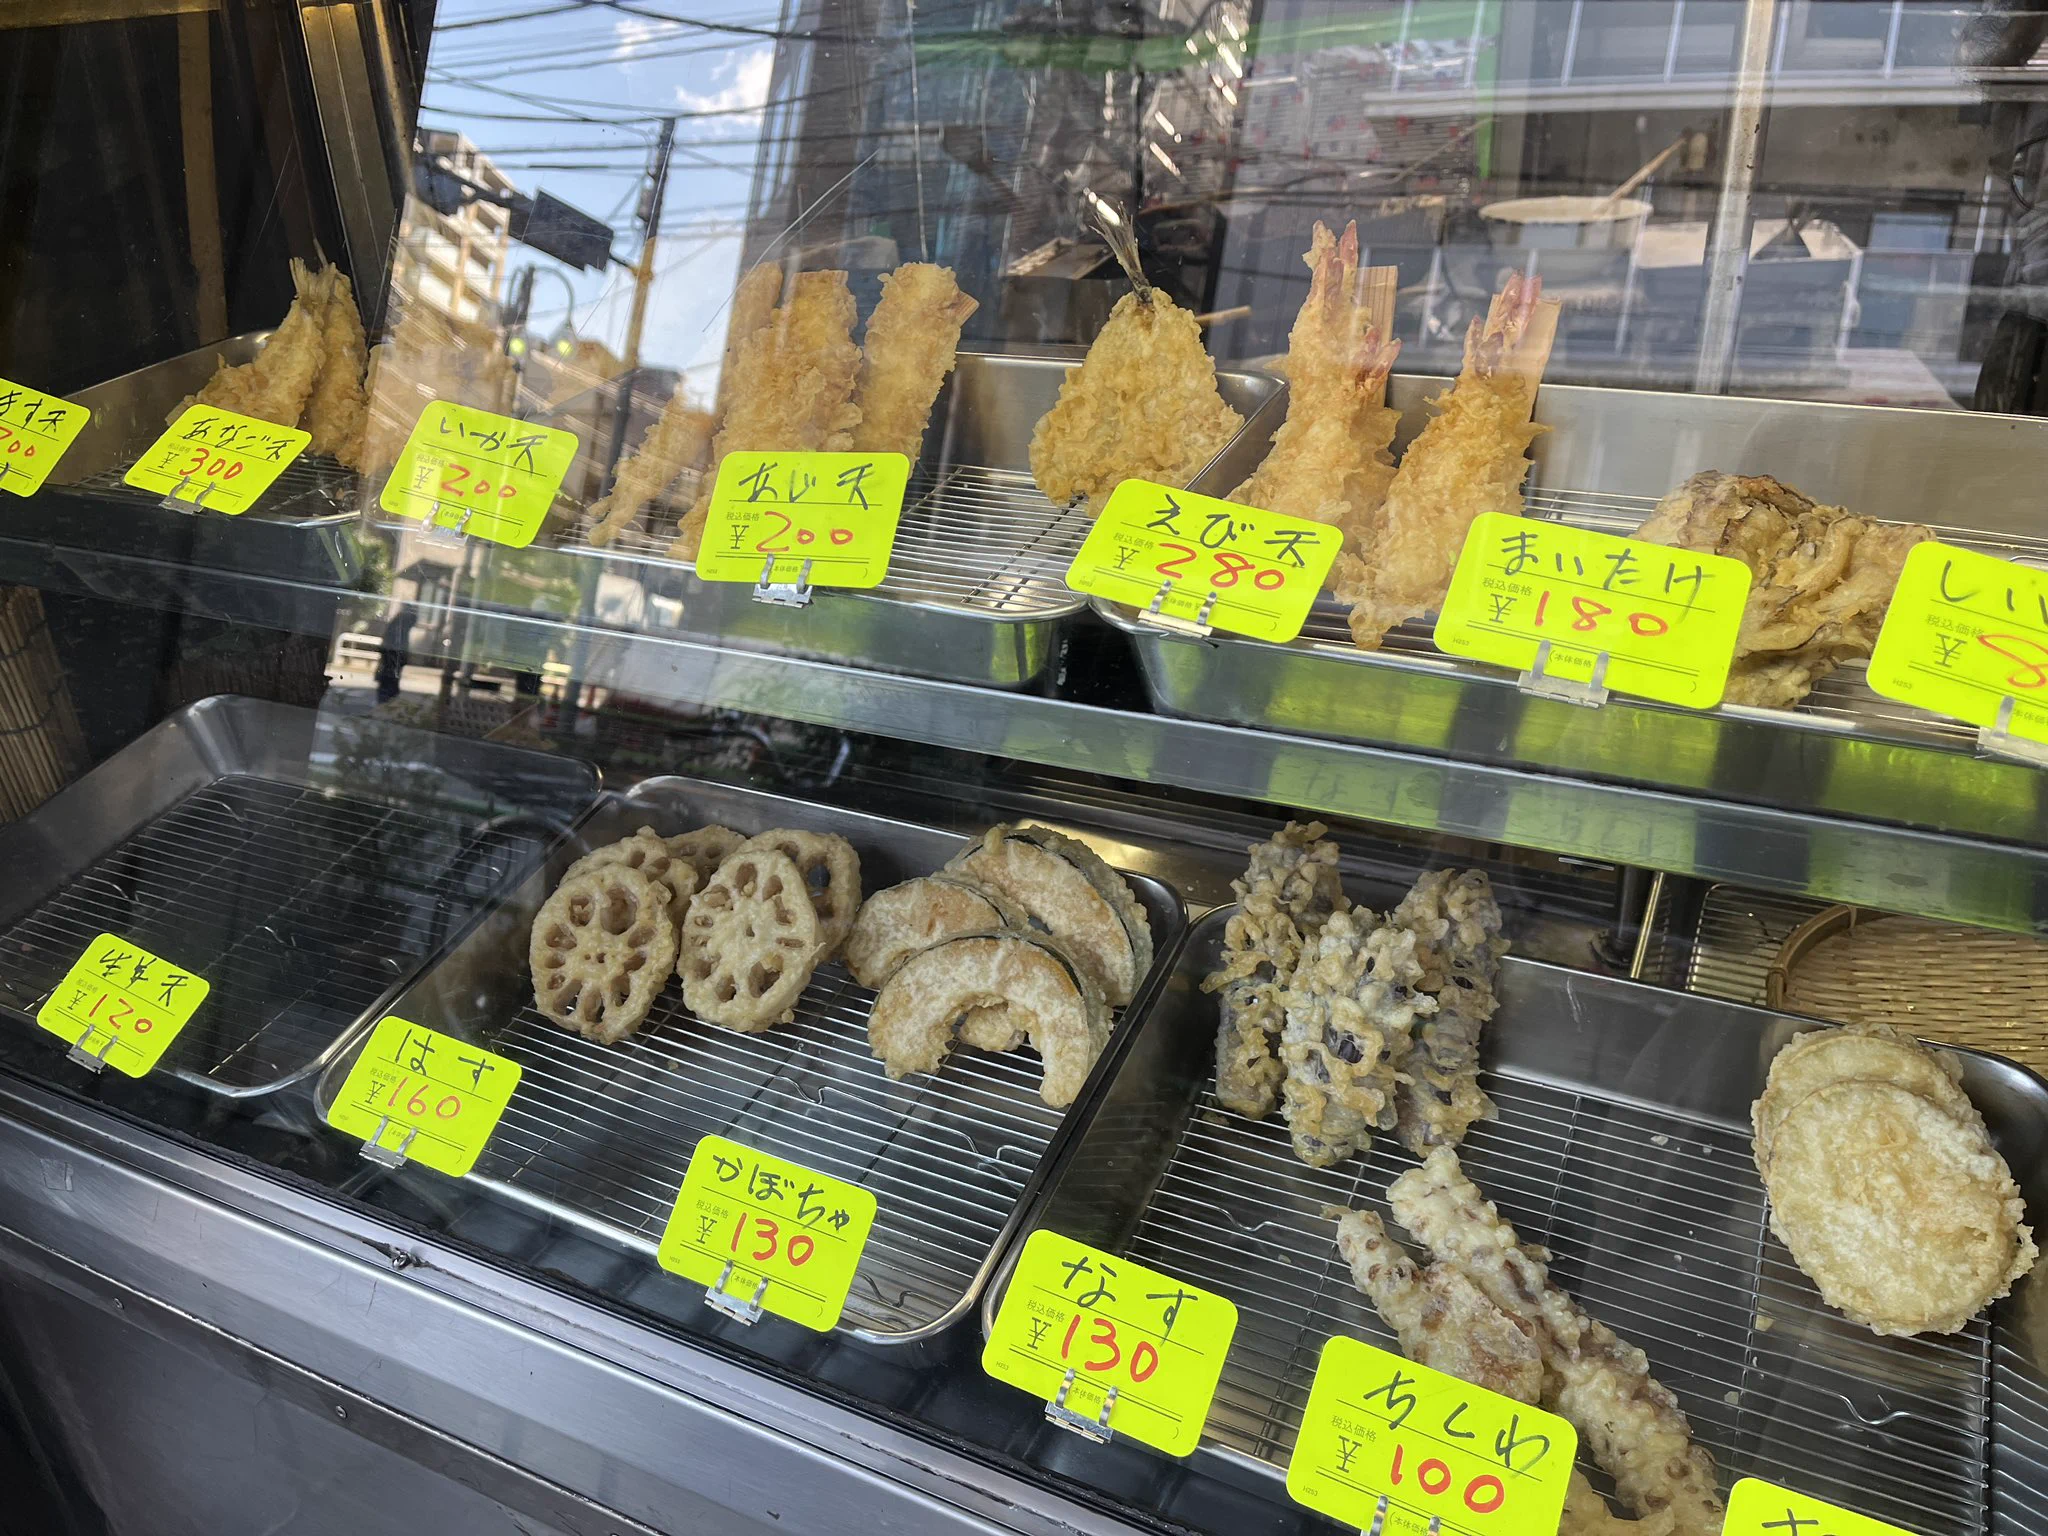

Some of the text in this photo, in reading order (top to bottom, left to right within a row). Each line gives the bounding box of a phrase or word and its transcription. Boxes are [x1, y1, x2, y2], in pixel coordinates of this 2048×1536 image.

[182, 418, 296, 460] あなご天
[440, 416, 548, 478] いか天
[738, 462, 875, 510] あじ天
[726, 511, 760, 522] 税込価格
[1147, 494, 1320, 567] えび天
[1112, 531, 1155, 551] 税込価格
[1481, 576, 1533, 596] 税込価格
[1501, 530, 1716, 624] まいたけ
[1926, 613, 1986, 639] 税込価格
[395, 1029, 495, 1093] はす
[695, 1199, 729, 1219] 税込価格
[712, 1154, 850, 1232] かぼちゃ
[1026, 1298, 1066, 1323] 税込価格
[1061, 1256, 1199, 1347] なす
[1330, 1414, 1378, 1444] 税込価格
[1362, 1369, 1551, 1480] ちくわ
